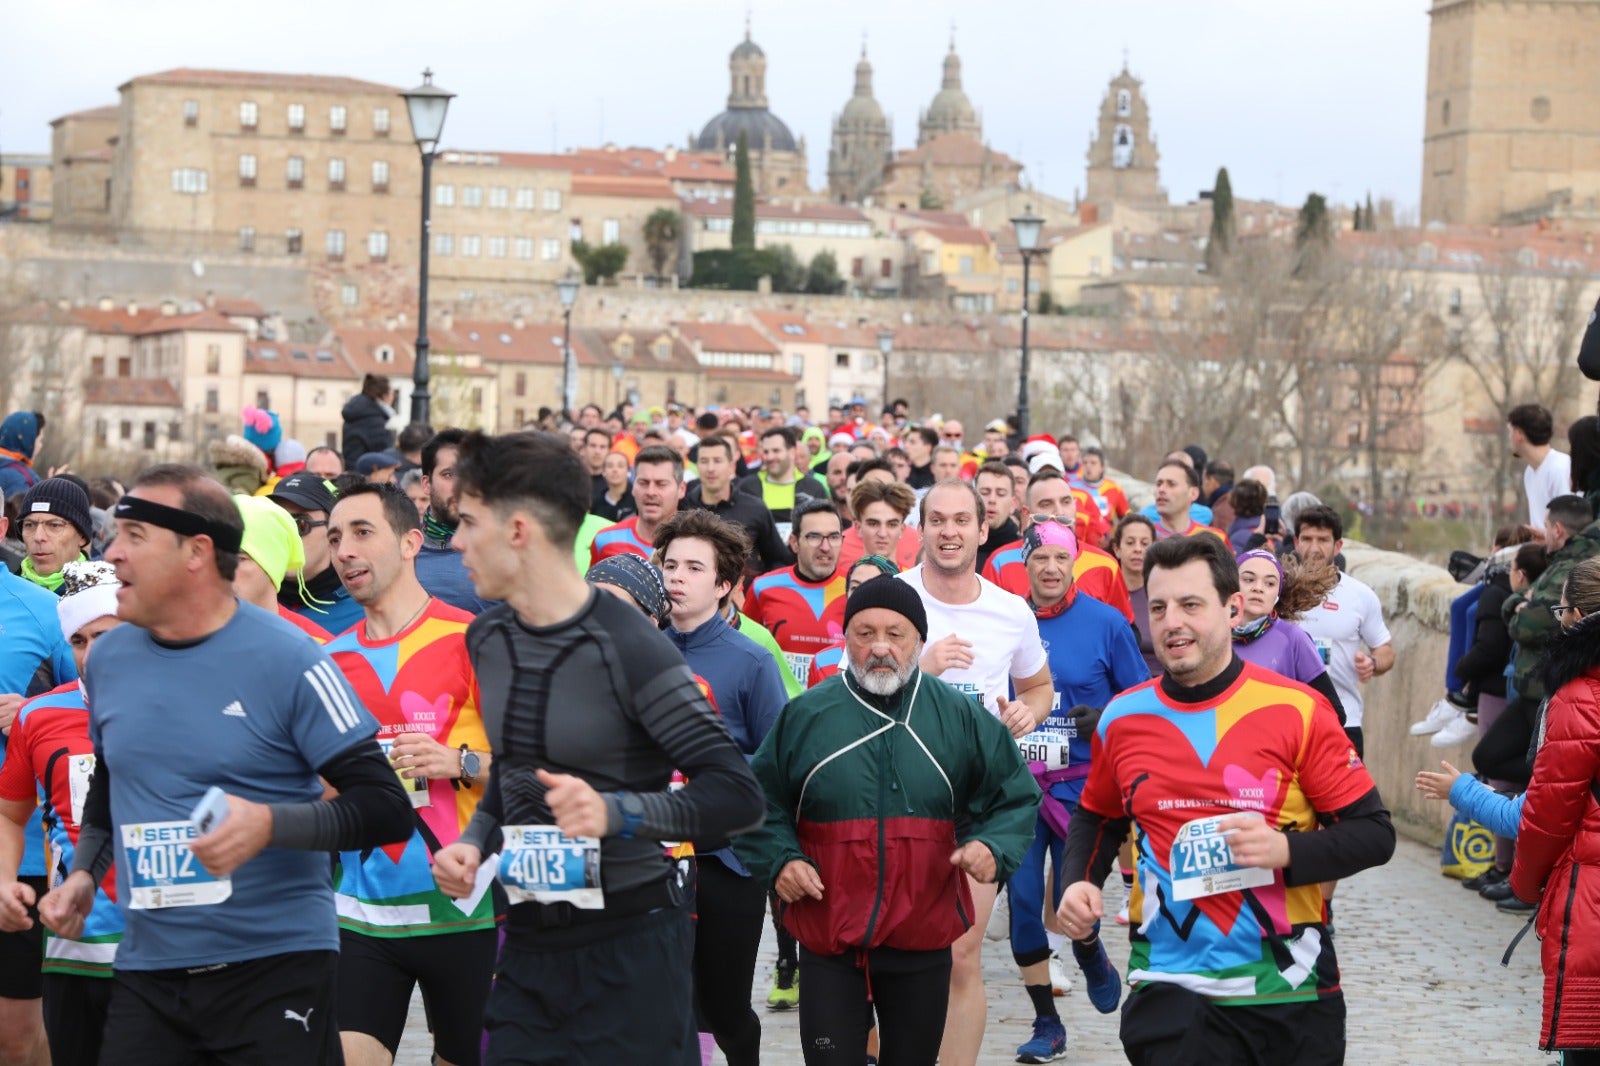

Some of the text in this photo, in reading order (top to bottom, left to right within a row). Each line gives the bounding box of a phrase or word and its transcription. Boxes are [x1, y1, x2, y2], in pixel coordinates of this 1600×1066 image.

[949, 682, 980, 692] TEL
[413, 711, 436, 721] XXXIX
[376, 722, 437, 736] STRE SALMANTINA
[1023, 734, 1063, 744] SETEL
[1238, 787, 1265, 799] XXXIX
[1157, 800, 1174, 811] SAN
[144, 826, 197, 842] SETE
[136, 844, 197, 881] 4012
[507, 847, 567, 885] 4013
